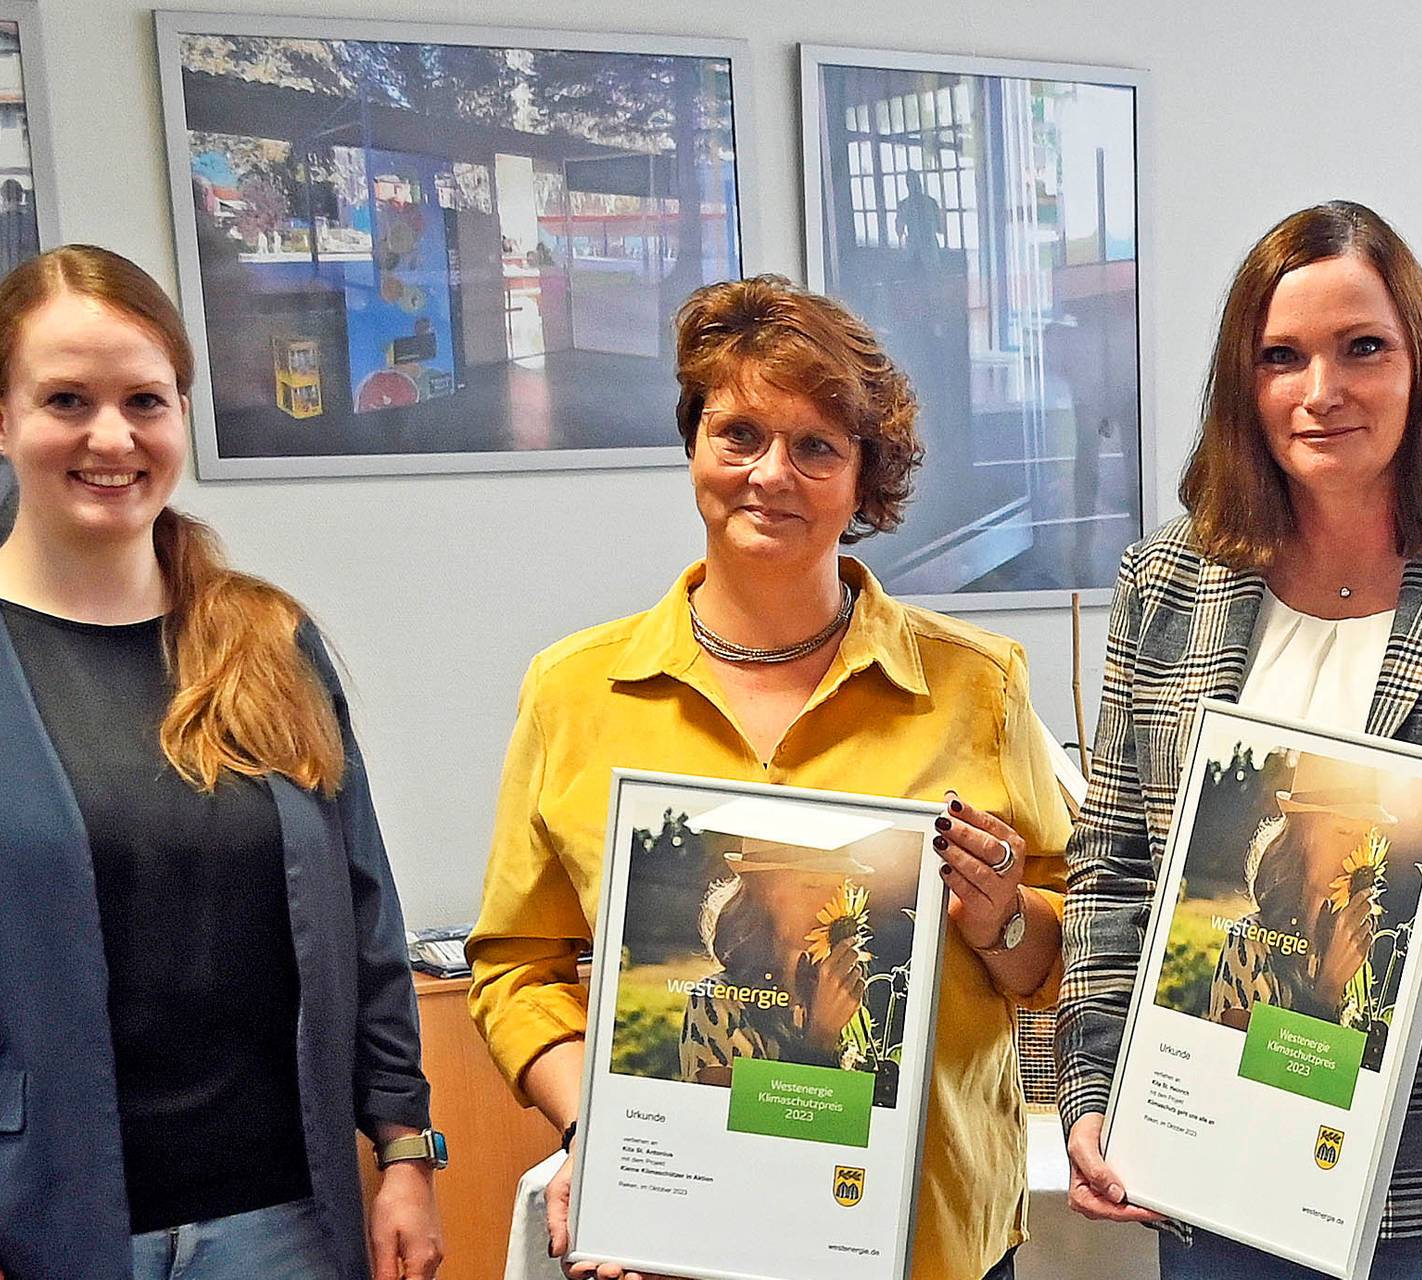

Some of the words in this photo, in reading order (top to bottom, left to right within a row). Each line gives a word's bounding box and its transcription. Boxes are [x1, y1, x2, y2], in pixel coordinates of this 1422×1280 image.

[1211, 914, 1309, 955] westenergie
[666, 978, 790, 1010] westenergie
[1279, 1027, 1331, 1053] Westenergie
[1159, 1042, 1191, 1060] Urkunde
[1267, 1040, 1336, 1070] Klimaschutzpreis
[1286, 1060, 1311, 1077] 2023
[770, 1079, 834, 1098] Westenergie
[758, 1091, 843, 1112] Klimaschutzpreis
[625, 1108, 666, 1123] Urkunde
[784, 1108, 814, 1122] 2023
